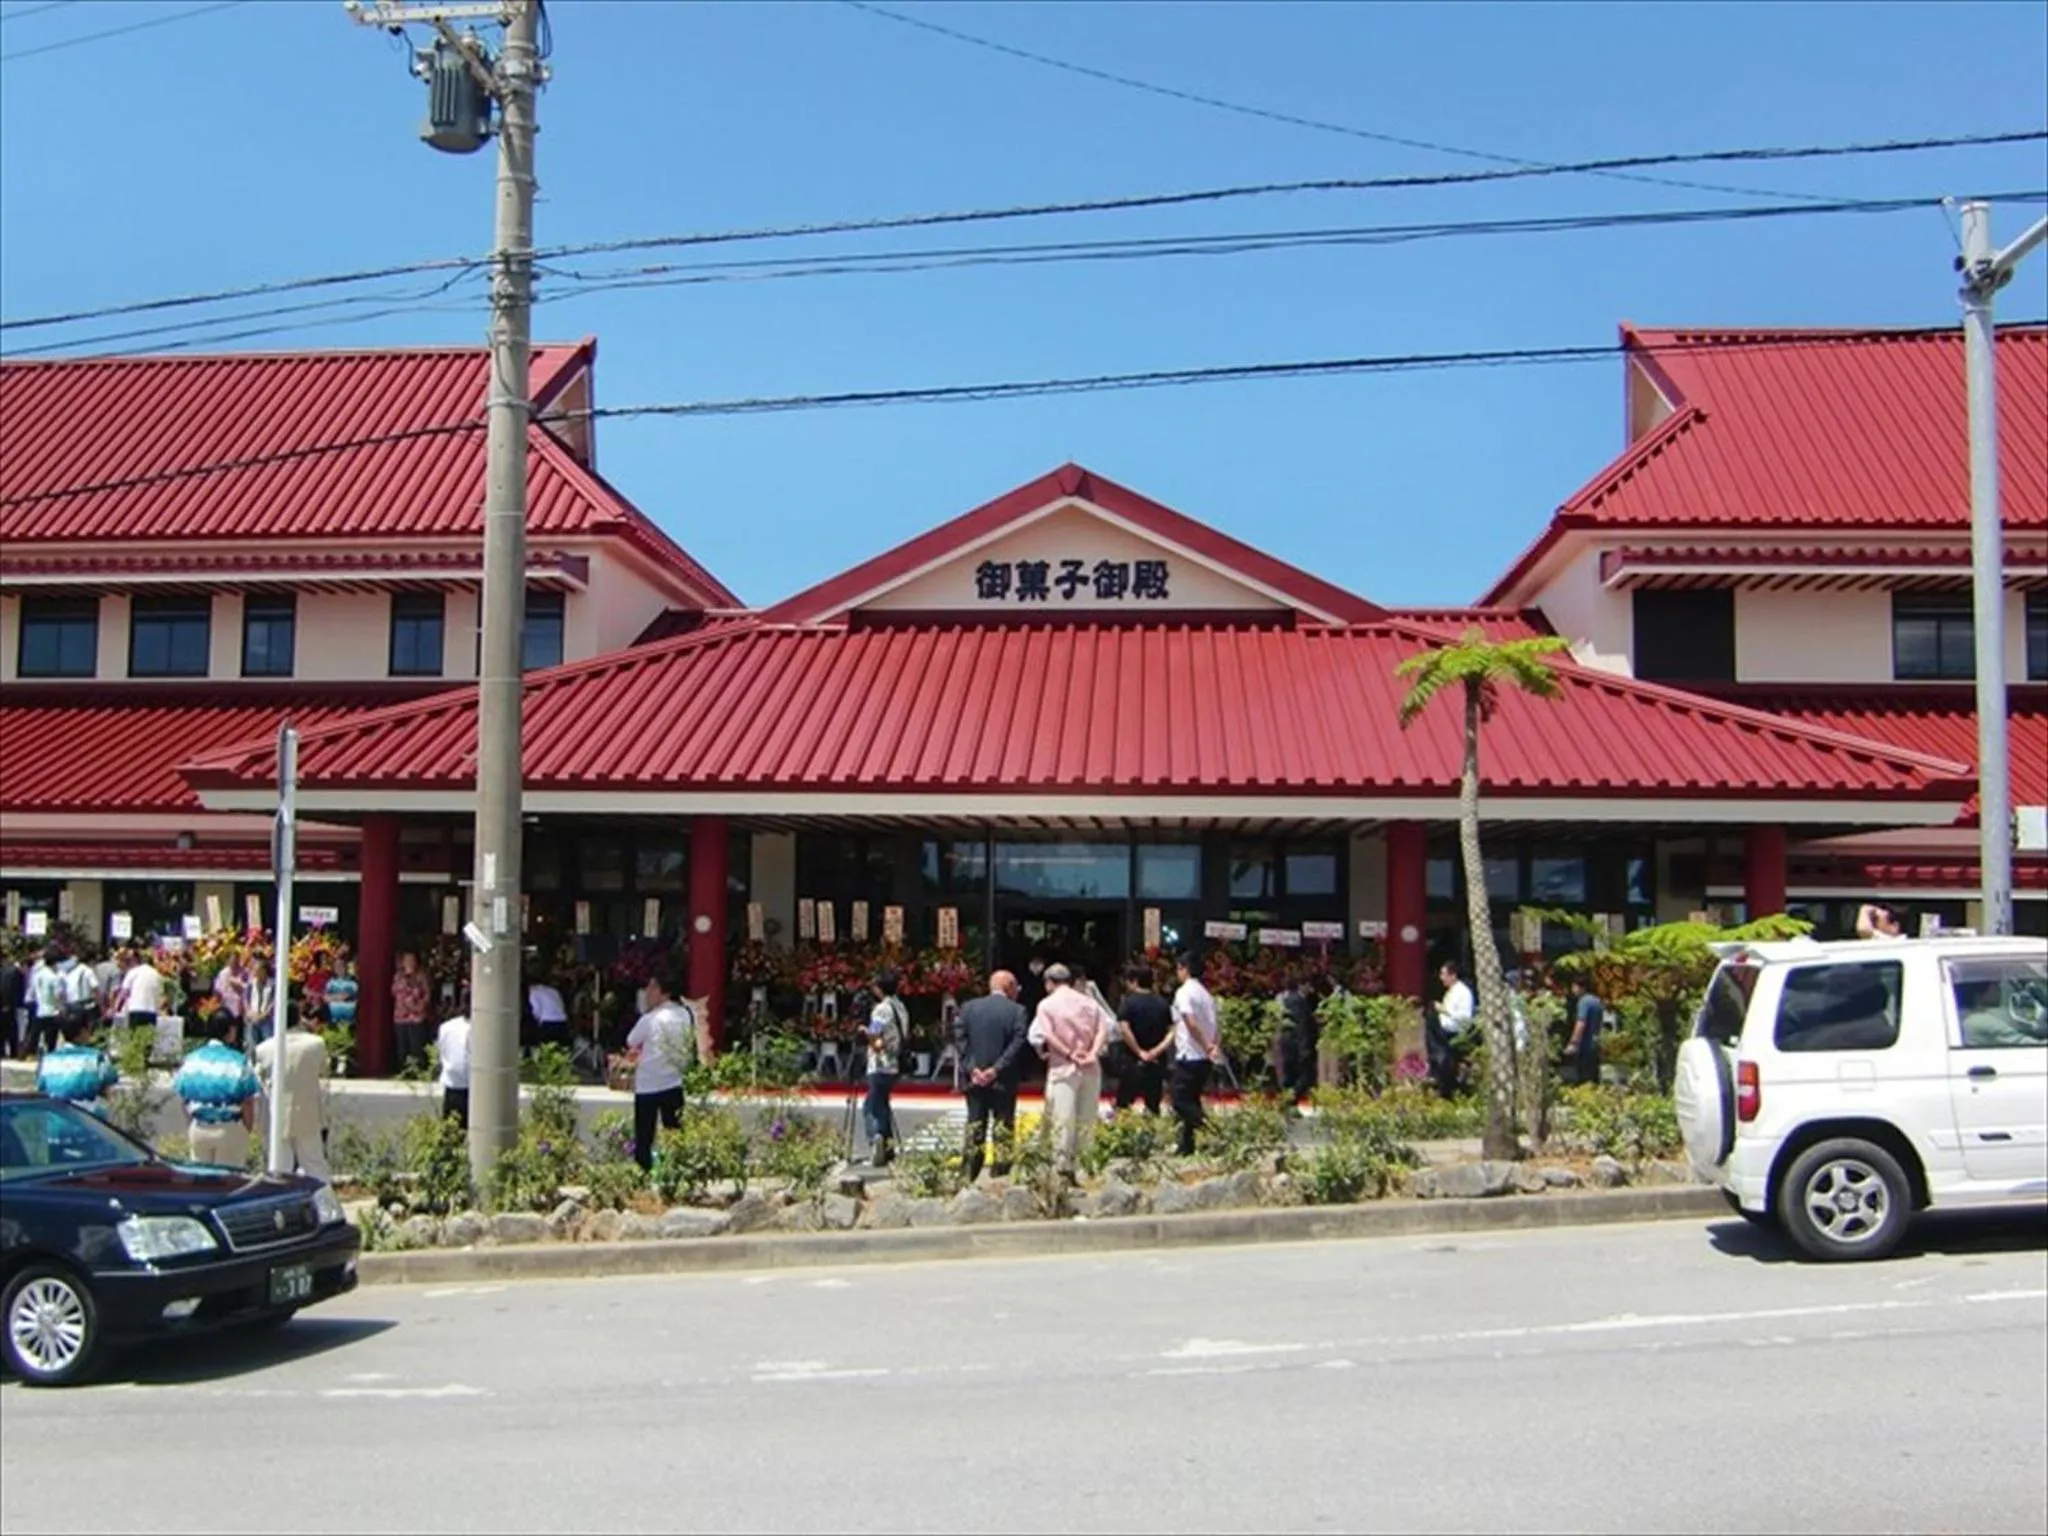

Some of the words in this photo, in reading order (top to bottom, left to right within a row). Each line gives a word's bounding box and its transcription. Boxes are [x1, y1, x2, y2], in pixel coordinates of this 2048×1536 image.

[976, 560, 1169, 601] 御菓子御殿
